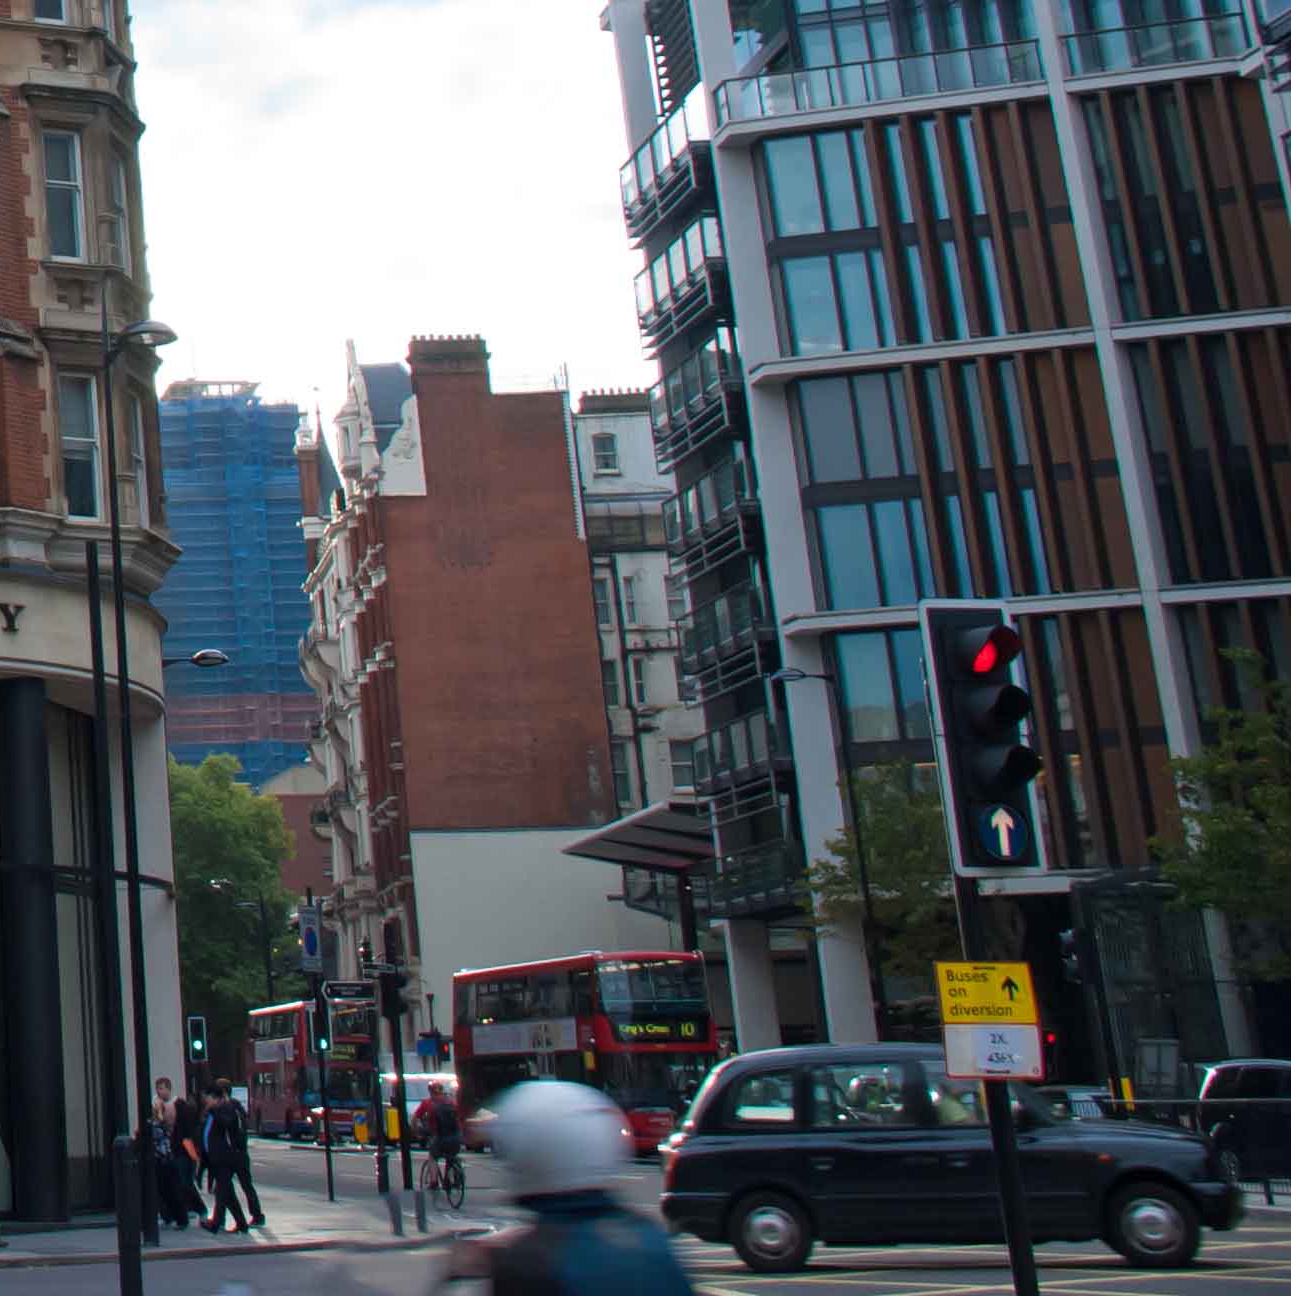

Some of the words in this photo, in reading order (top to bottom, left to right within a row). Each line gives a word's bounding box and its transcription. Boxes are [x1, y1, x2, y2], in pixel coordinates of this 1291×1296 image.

[945, 969, 988, 983] Buses
[948, 986, 967, 998] on
[949, 1003, 1013, 1017] diversion
[681, 1022, 695, 1037] 10
